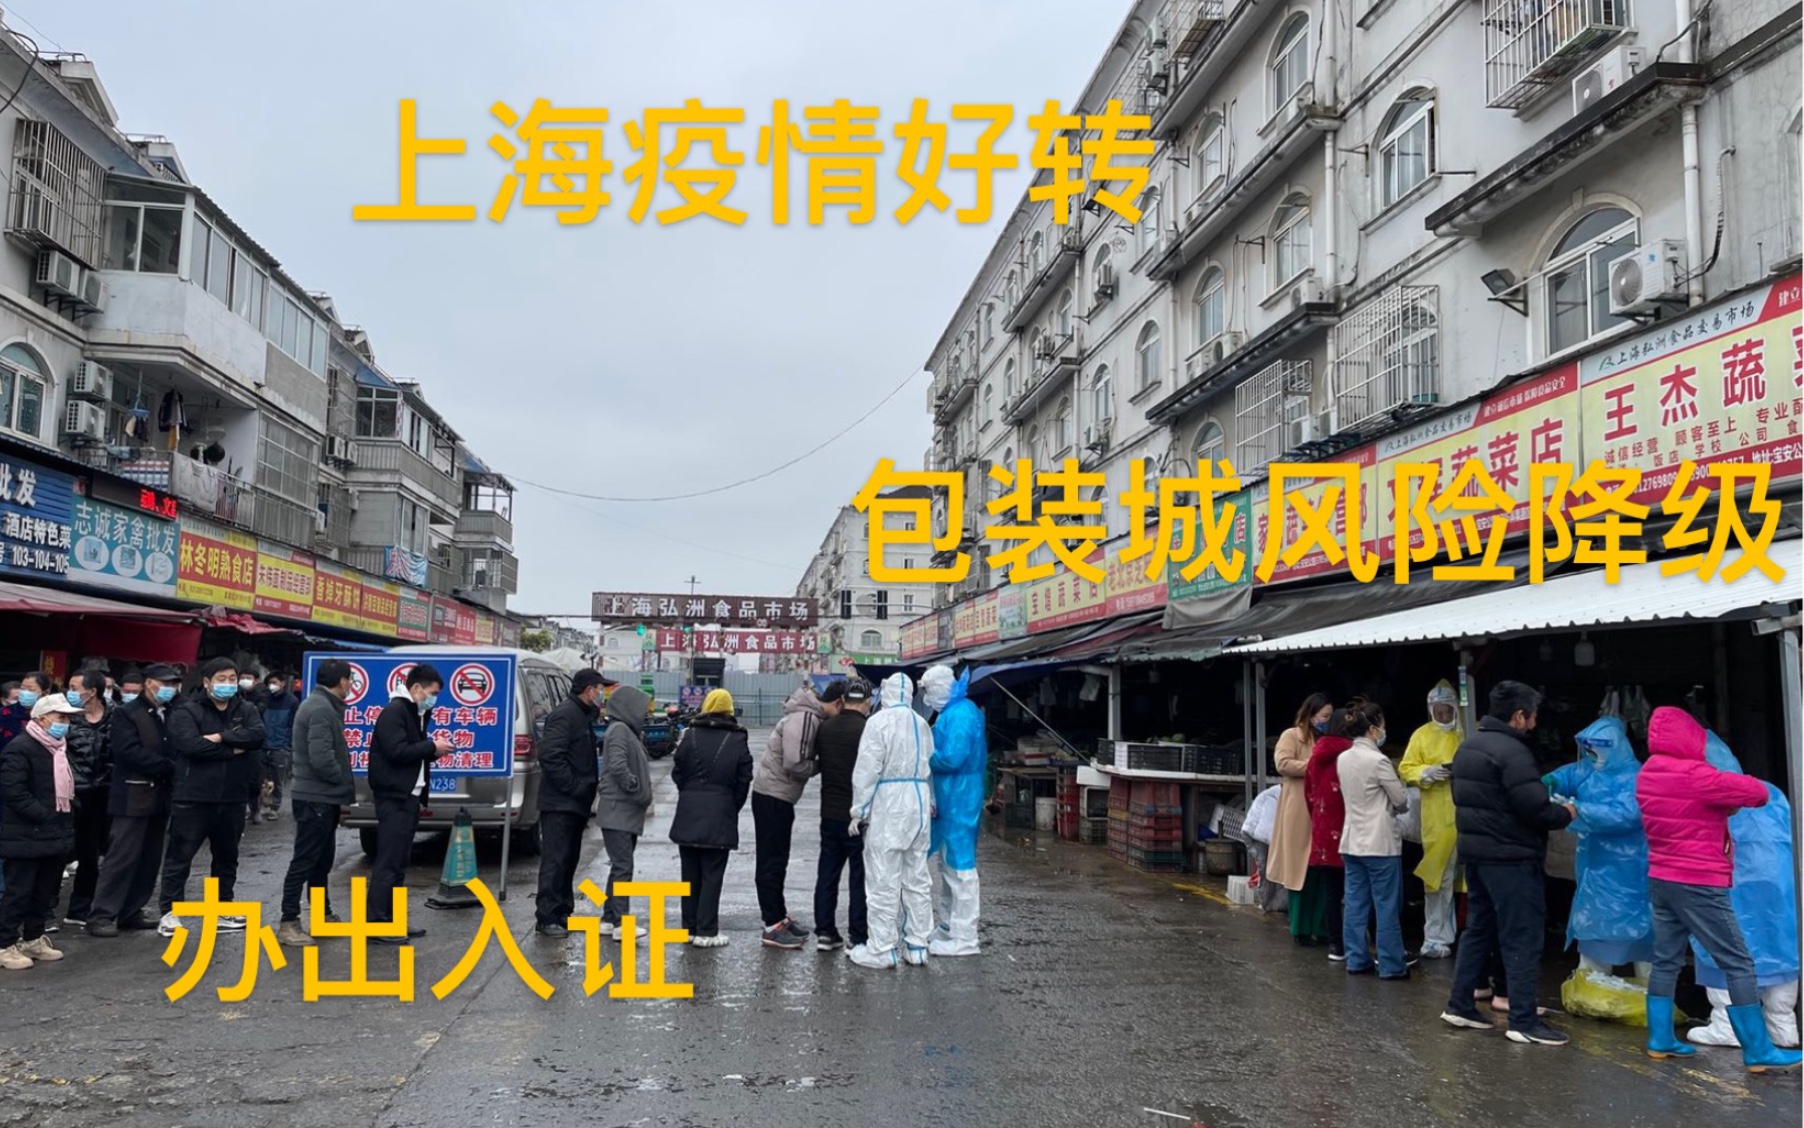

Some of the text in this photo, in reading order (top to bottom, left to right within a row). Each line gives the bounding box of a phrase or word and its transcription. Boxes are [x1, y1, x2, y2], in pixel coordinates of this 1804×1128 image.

[1604, 437, 1659, 464] 诚信经营
[1675, 417, 1737, 447] 顾客至上
[1695, 439, 1721, 457] 学校
[1739, 427, 1767, 447] 公司
[6, 511, 71, 549] 酒店特色菜
[75, 501, 175, 556] 志诚家禽批发
[12, 545, 70, 573] 103-104-105
[181, 539, 254, 586] 林冬明熟食店
[604, 598, 809, 621] 上海弘洲食品市场
[660, 632, 816, 651] 上海弘洲食品市场
[431, 707, 498, 726] 有车辆
